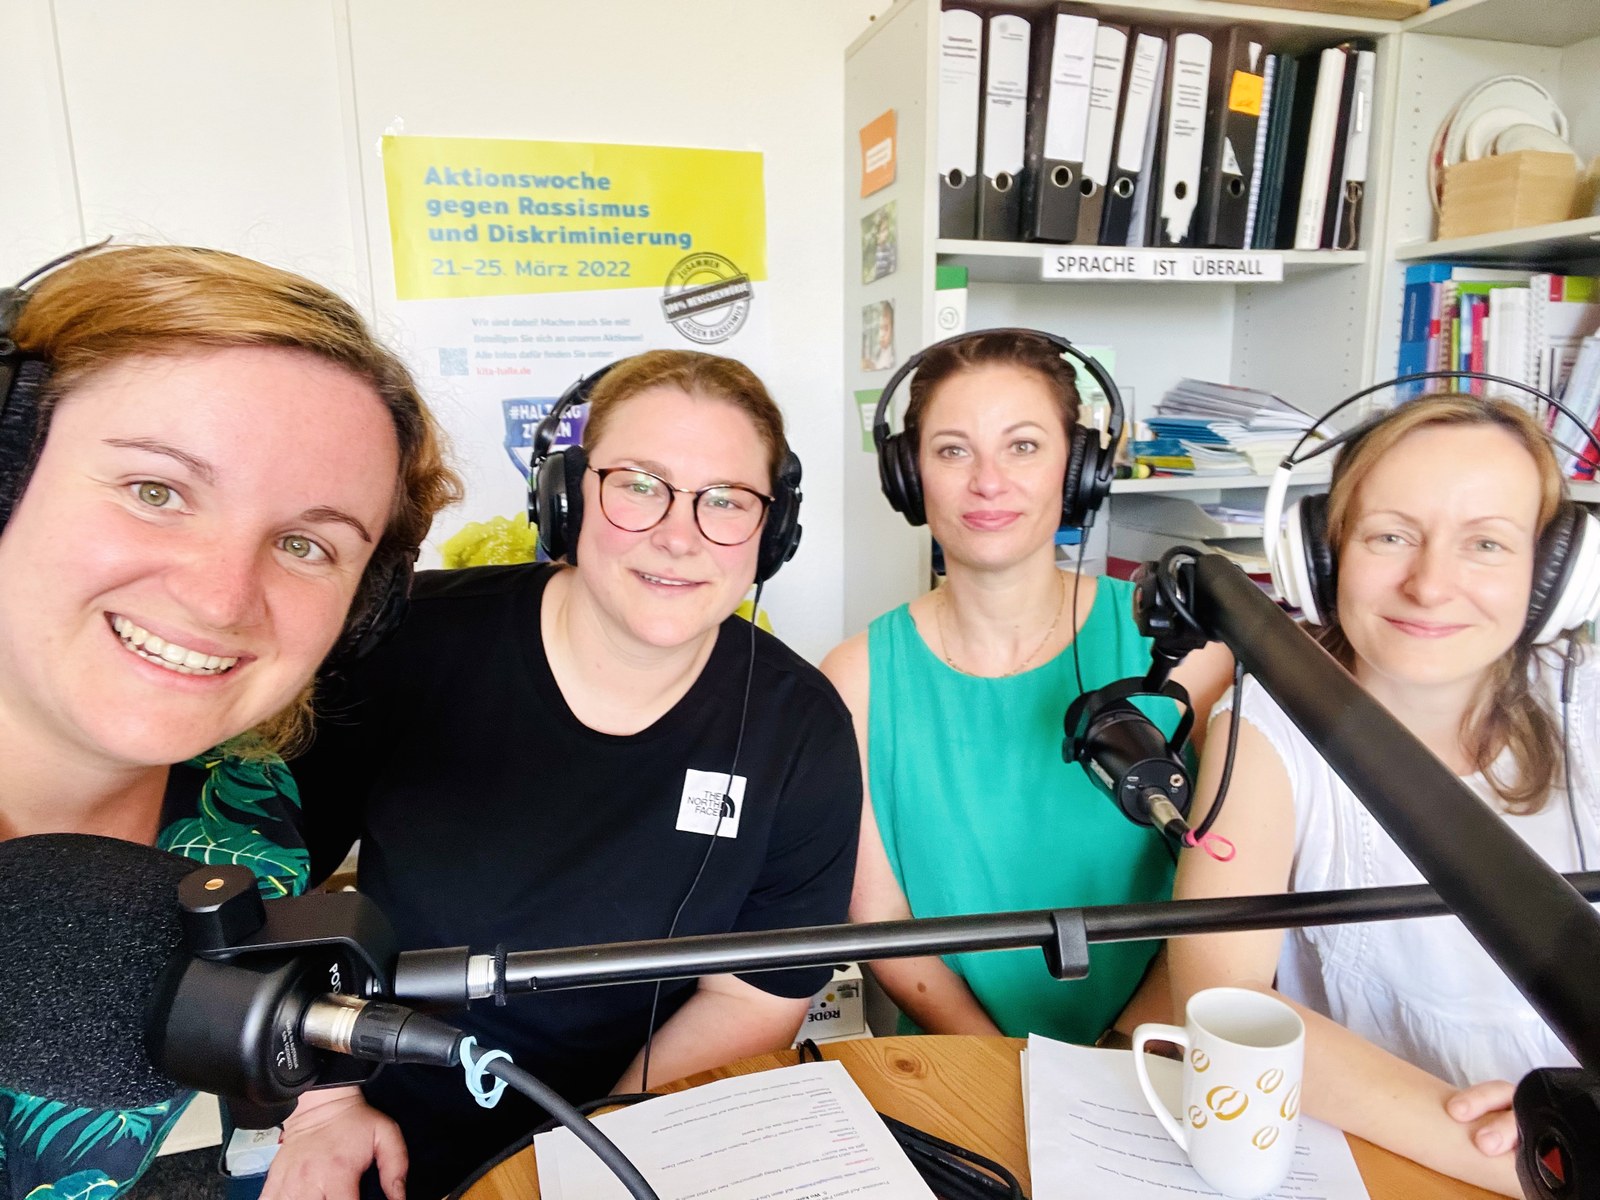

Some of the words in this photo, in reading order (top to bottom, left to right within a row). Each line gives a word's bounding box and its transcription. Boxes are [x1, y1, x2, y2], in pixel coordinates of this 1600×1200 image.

[424, 166, 611, 191] Aktionswoche
[426, 199, 509, 218] gegen
[518, 196, 650, 218] Rassismus
[429, 224, 478, 242] und
[488, 224, 692, 249] Diskriminierung
[515, 260, 568, 277] März
[577, 260, 631, 278] 2022
[1057, 256, 1136, 273] SPRACHE
[1153, 259, 1177, 276] IST
[1193, 256, 1263, 276] ÜBERALL
[472, 318, 489, 327] Wir
[491, 318, 510, 327] sind
[540, 318, 575, 327] Machen
[599, 318, 613, 326] Sie
[520, 334, 534, 343] Sie
[687, 796, 720, 809] NORTH
[704, 790, 722, 801] THE
[695, 805, 720, 817] FACE
